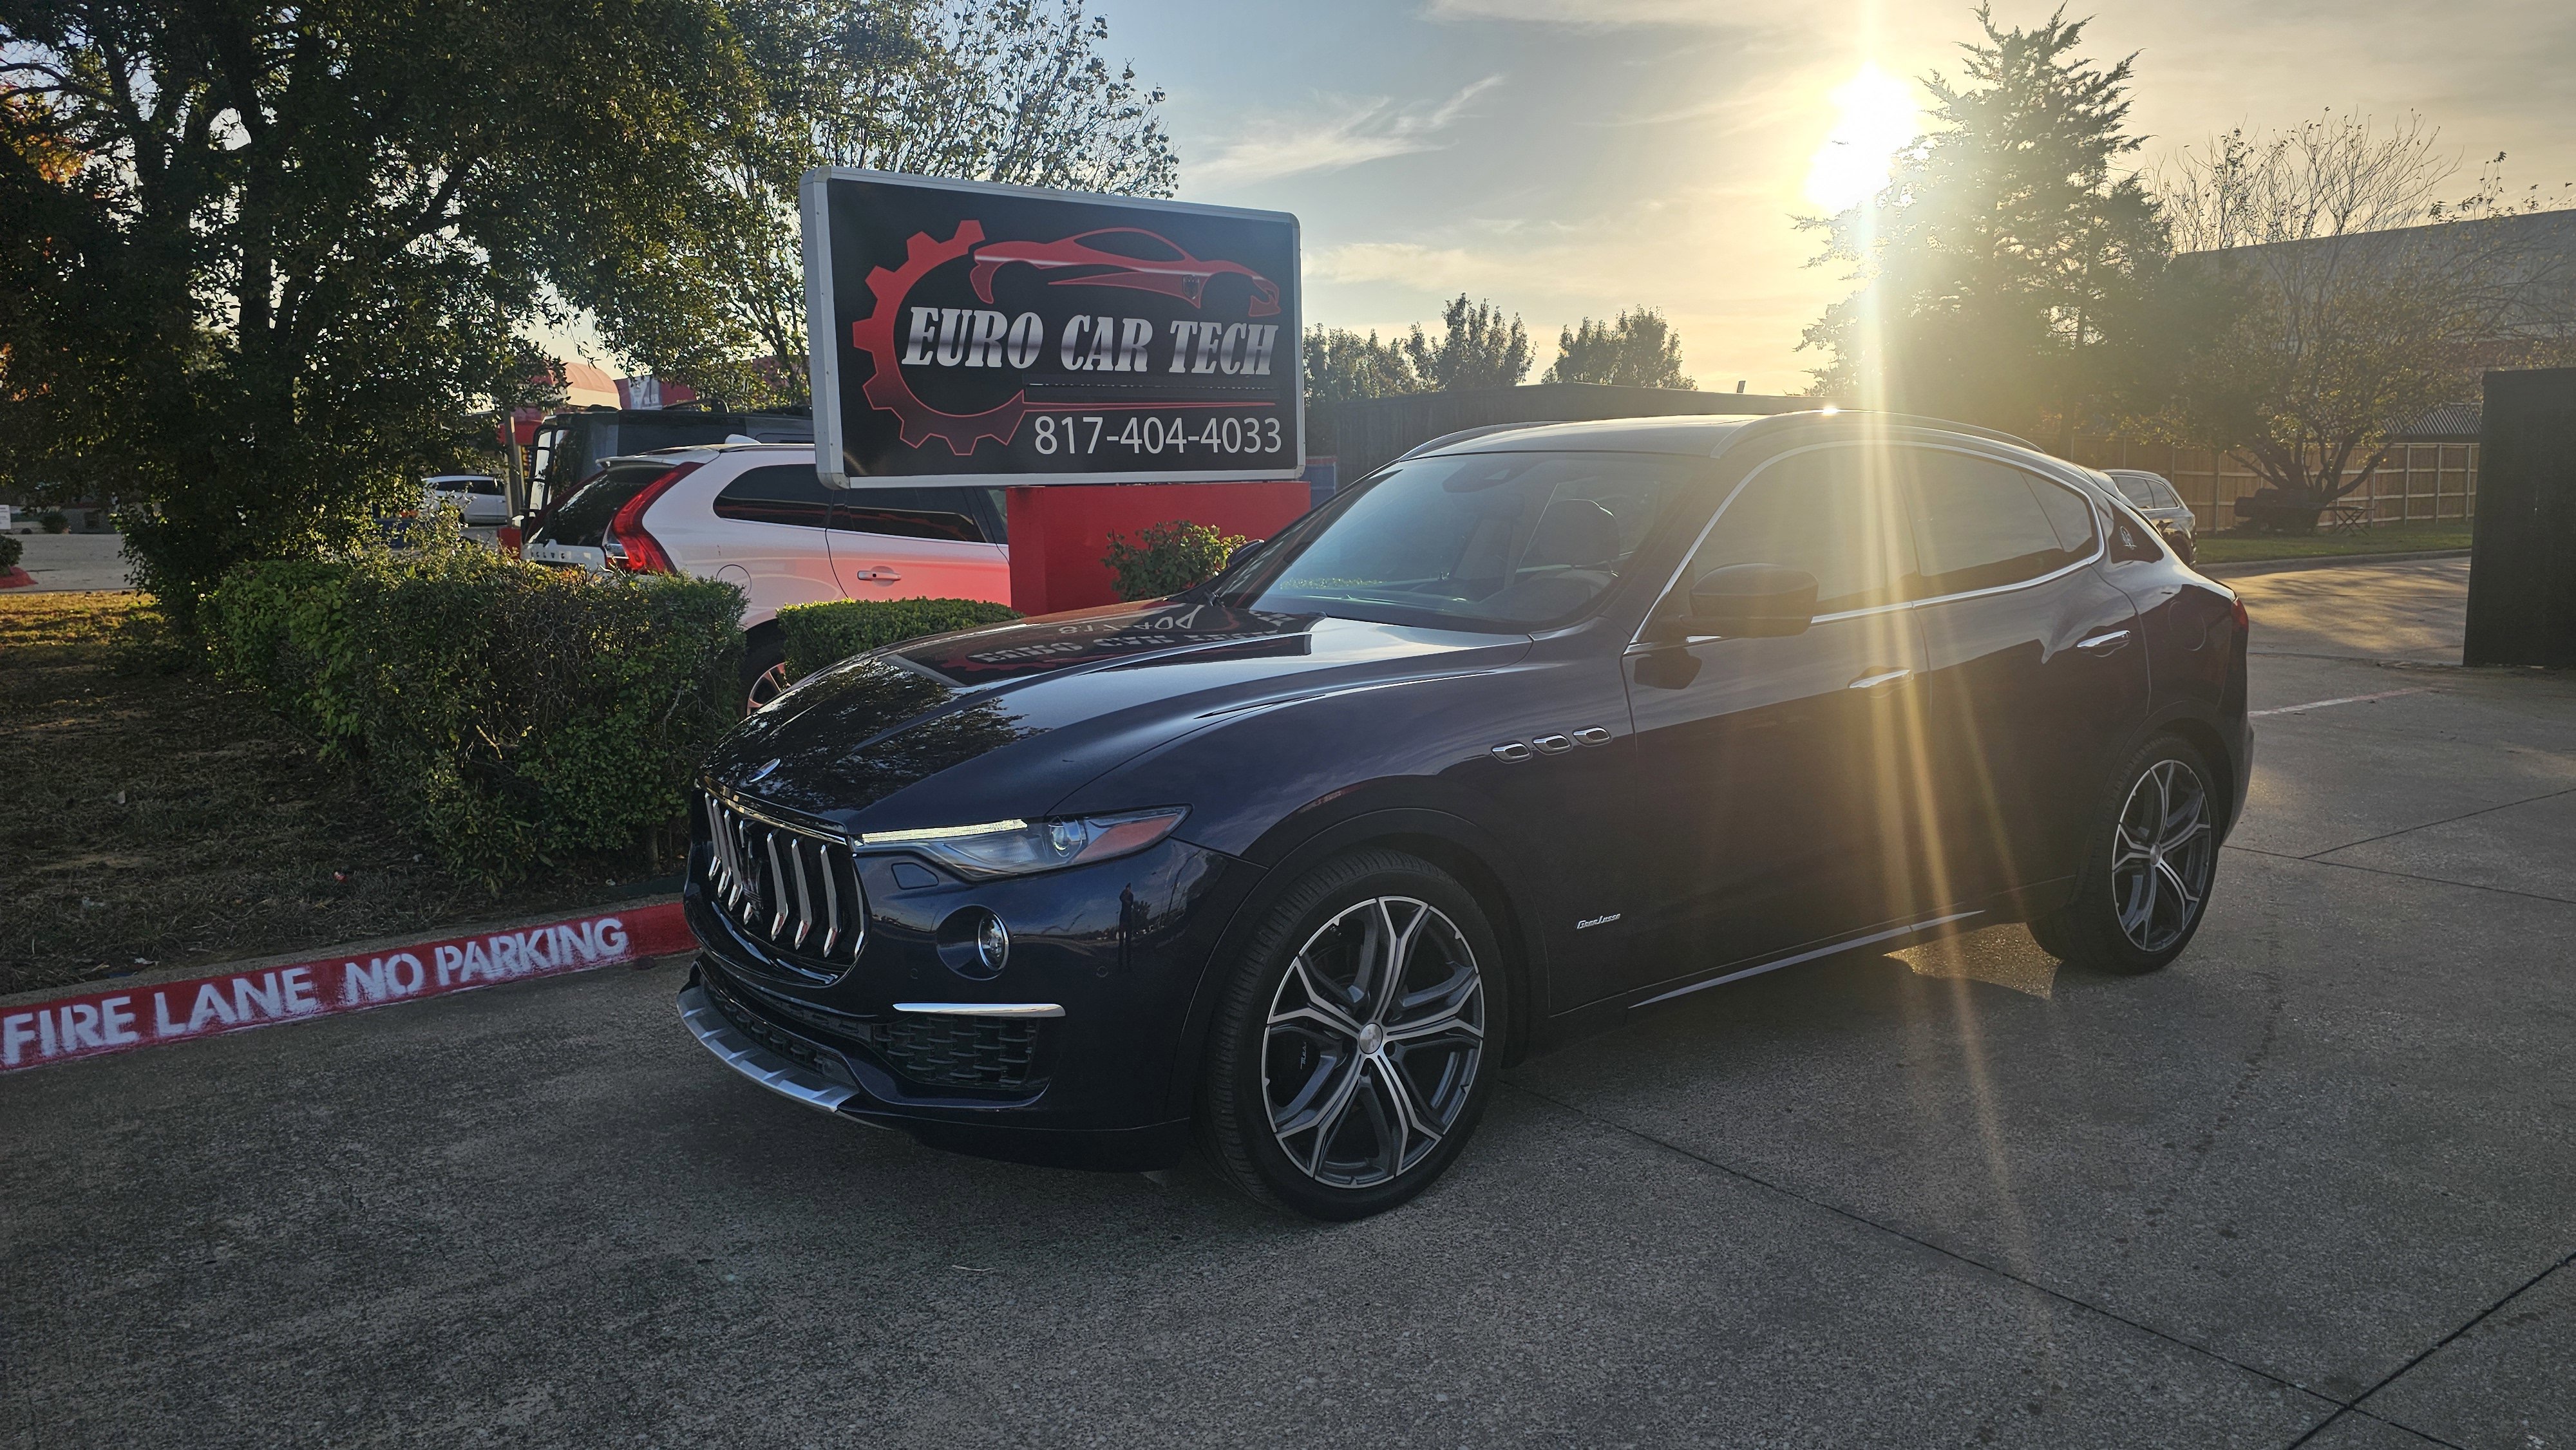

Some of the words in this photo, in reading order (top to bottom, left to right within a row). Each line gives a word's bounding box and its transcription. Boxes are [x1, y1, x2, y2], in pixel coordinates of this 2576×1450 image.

[902, 306, 1045, 370] EURO
[1061, 314, 1154, 373] CAR
[1169, 320, 1279, 375] TECH
[1034, 415, 1282, 455] 817-404-4033
[2, 996, 138, 1066] FIRE
[155, 967, 319, 1037] LANE
[343, 953, 425, 1006] NO
[435, 918, 629, 986] PARKING
